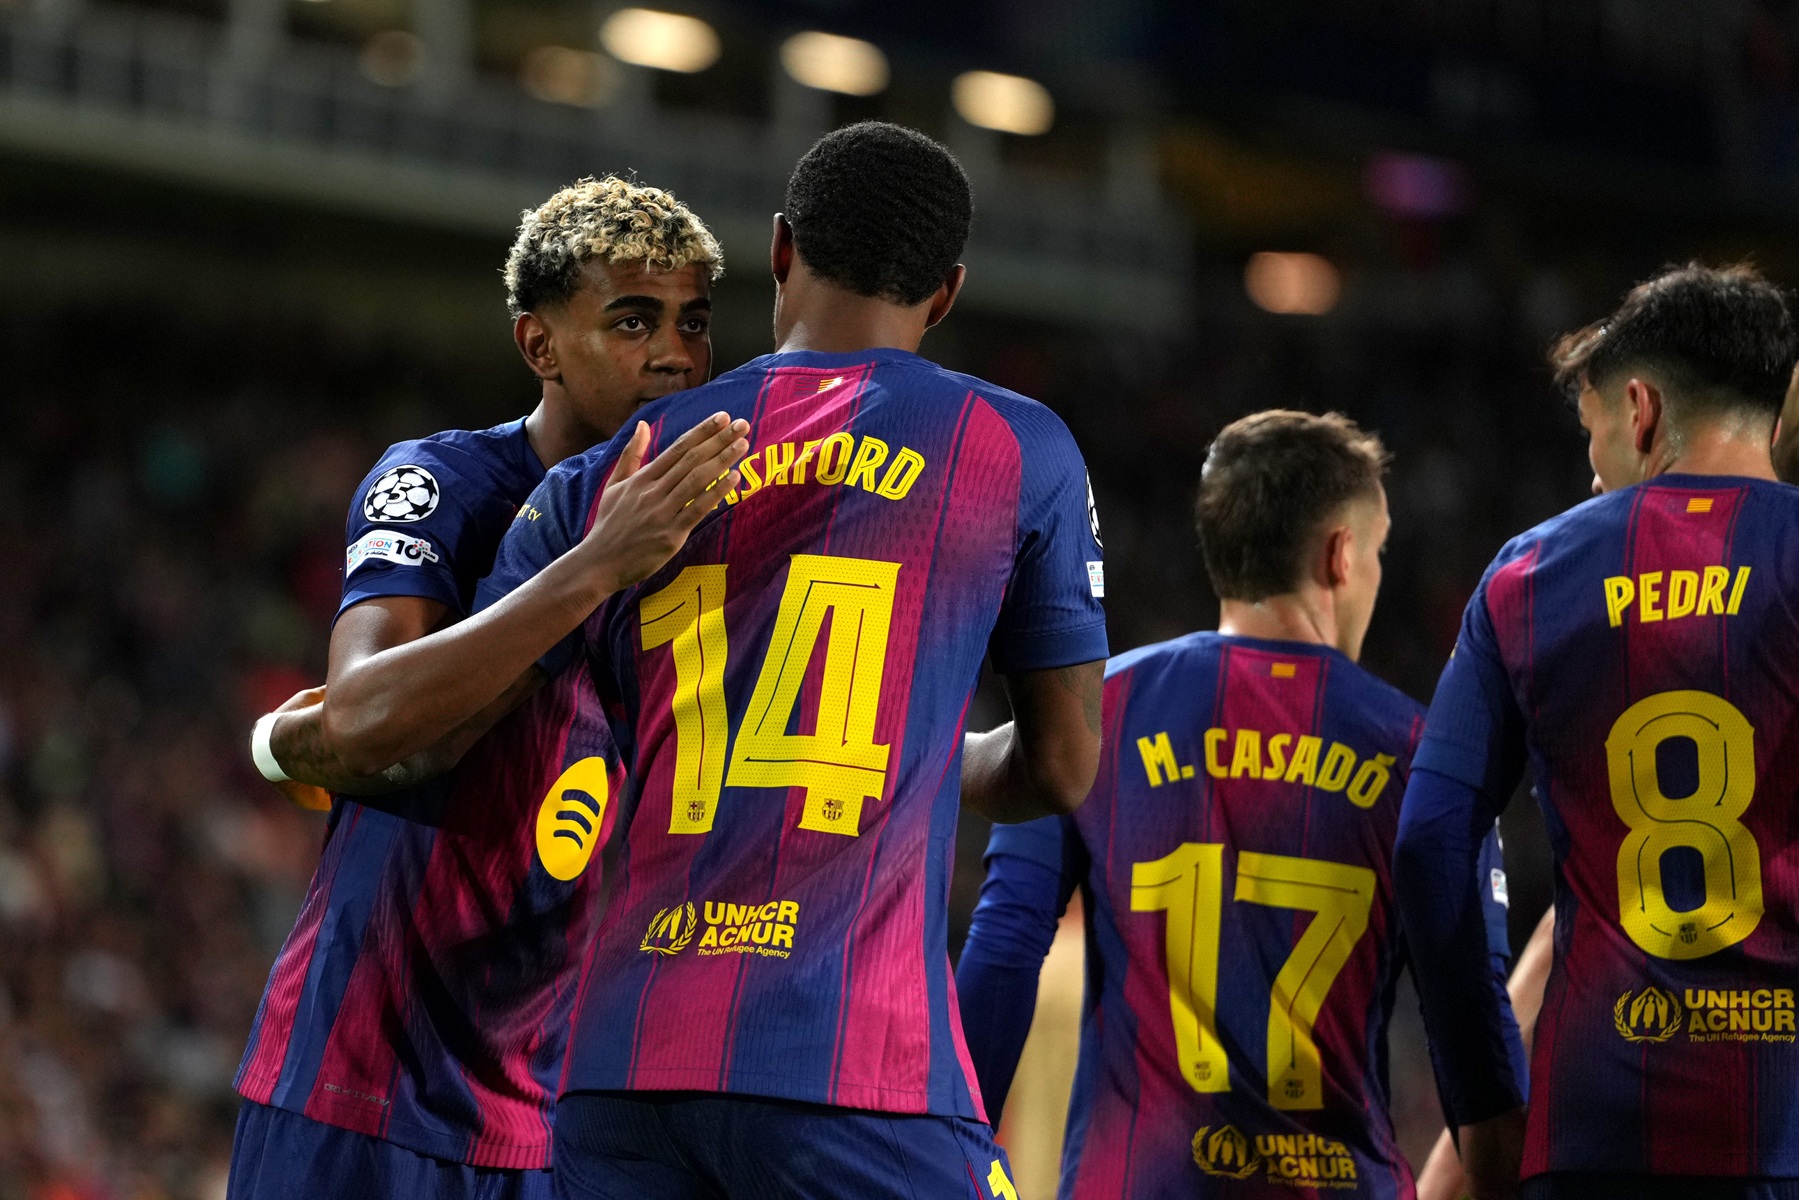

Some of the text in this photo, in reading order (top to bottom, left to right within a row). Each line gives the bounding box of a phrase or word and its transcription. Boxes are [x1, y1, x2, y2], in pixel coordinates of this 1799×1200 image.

[686, 432, 926, 509] SHFORD
[1603, 565, 1752, 628] PEDRI
[639, 554, 903, 837] 14
[1136, 727, 1396, 808] M. CASADÓ
[1604, 689, 1765, 961] 8
[703, 900, 799, 926] UNHCR
[697, 948, 711, 956] The
[711, 948, 724, 956] UN
[755, 946, 791, 959] Agency
[698, 923, 795, 949] ACNUR
[1130, 842, 1376, 1111] 17
[1685, 988, 1795, 1009] UNHCR
[1688, 1009, 1796, 1033] ACNUR
[1689, 1033, 1796, 1043] The UN Refugee Agency
